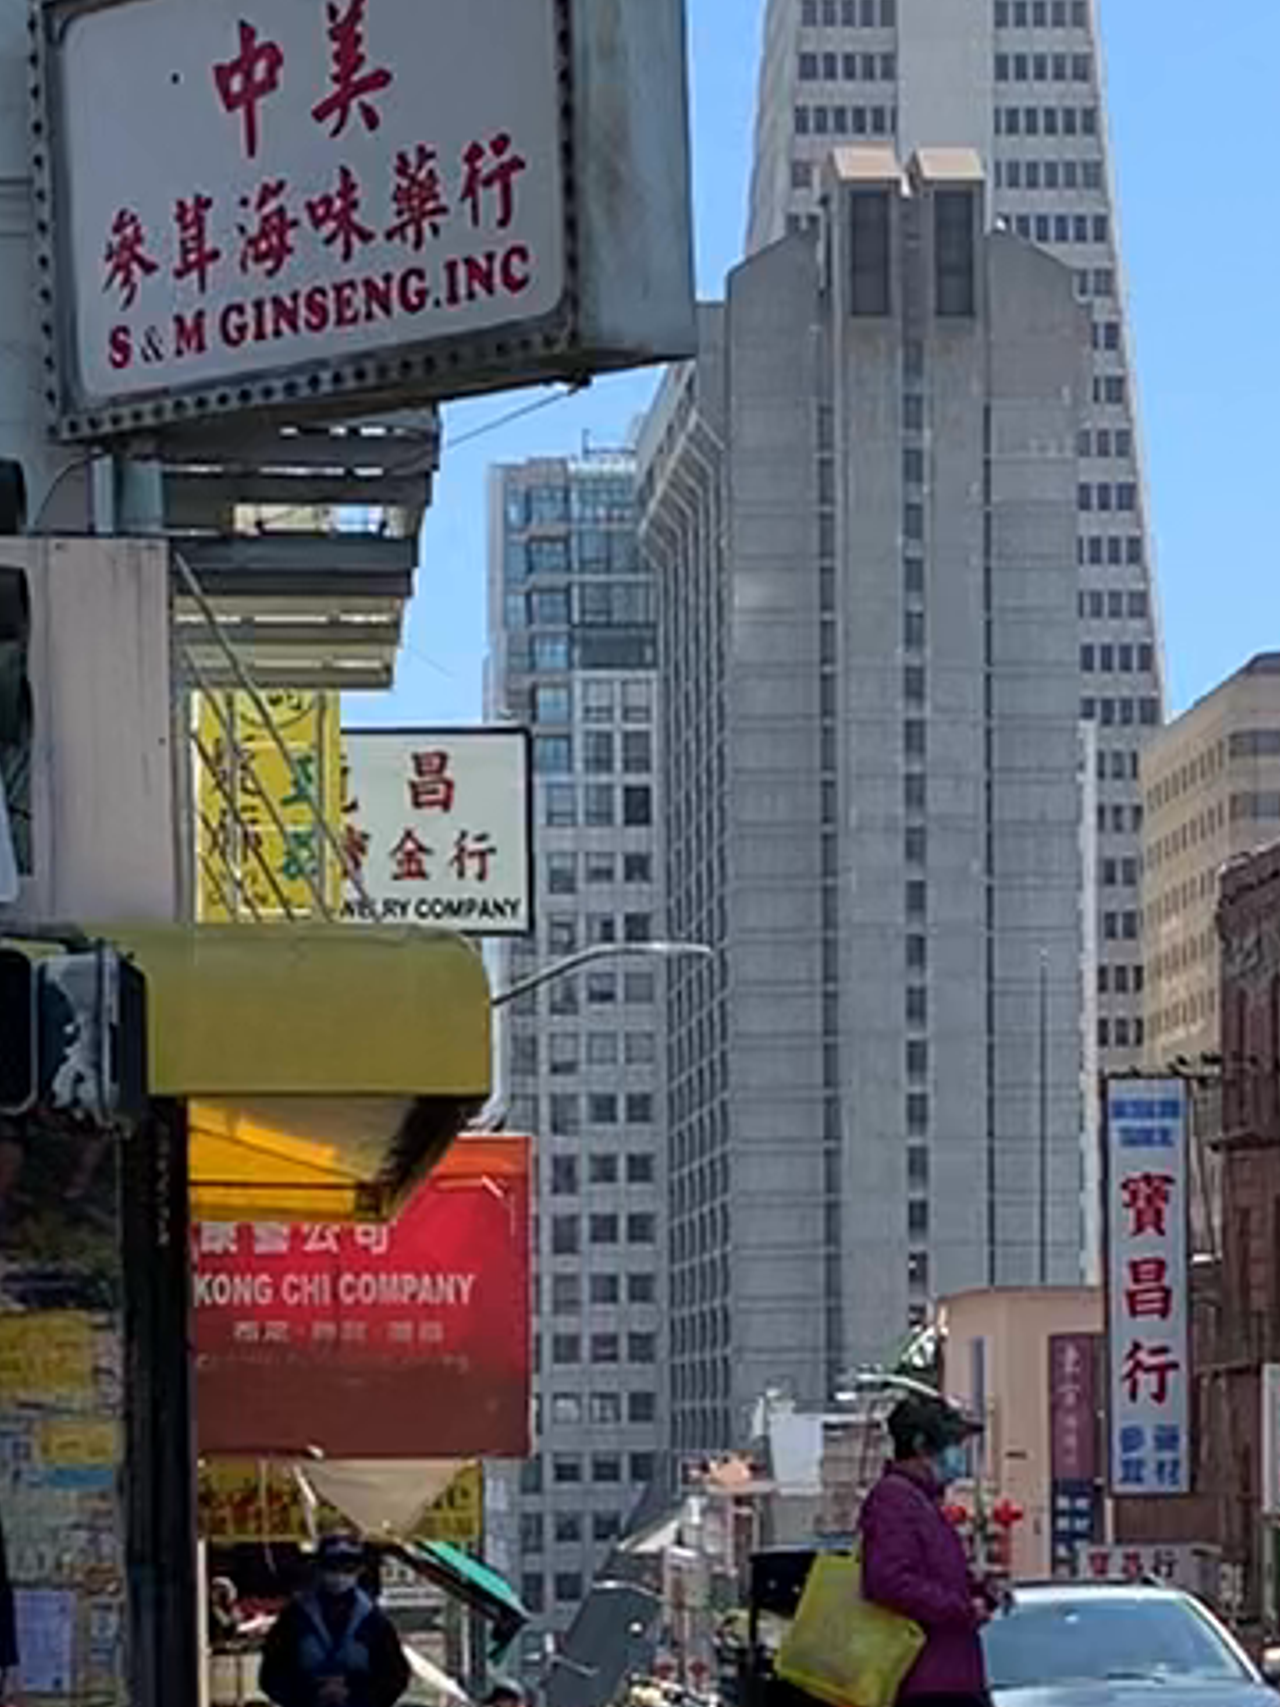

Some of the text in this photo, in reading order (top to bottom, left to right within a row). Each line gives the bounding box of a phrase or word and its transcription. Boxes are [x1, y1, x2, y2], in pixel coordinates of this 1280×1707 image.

[108, 245, 530, 370] S & M GINSENG.INC
[414, 897, 521, 920] COMPANY
[281, 1272, 332, 1306] CHI
[339, 1273, 477, 1306] COMPANY
